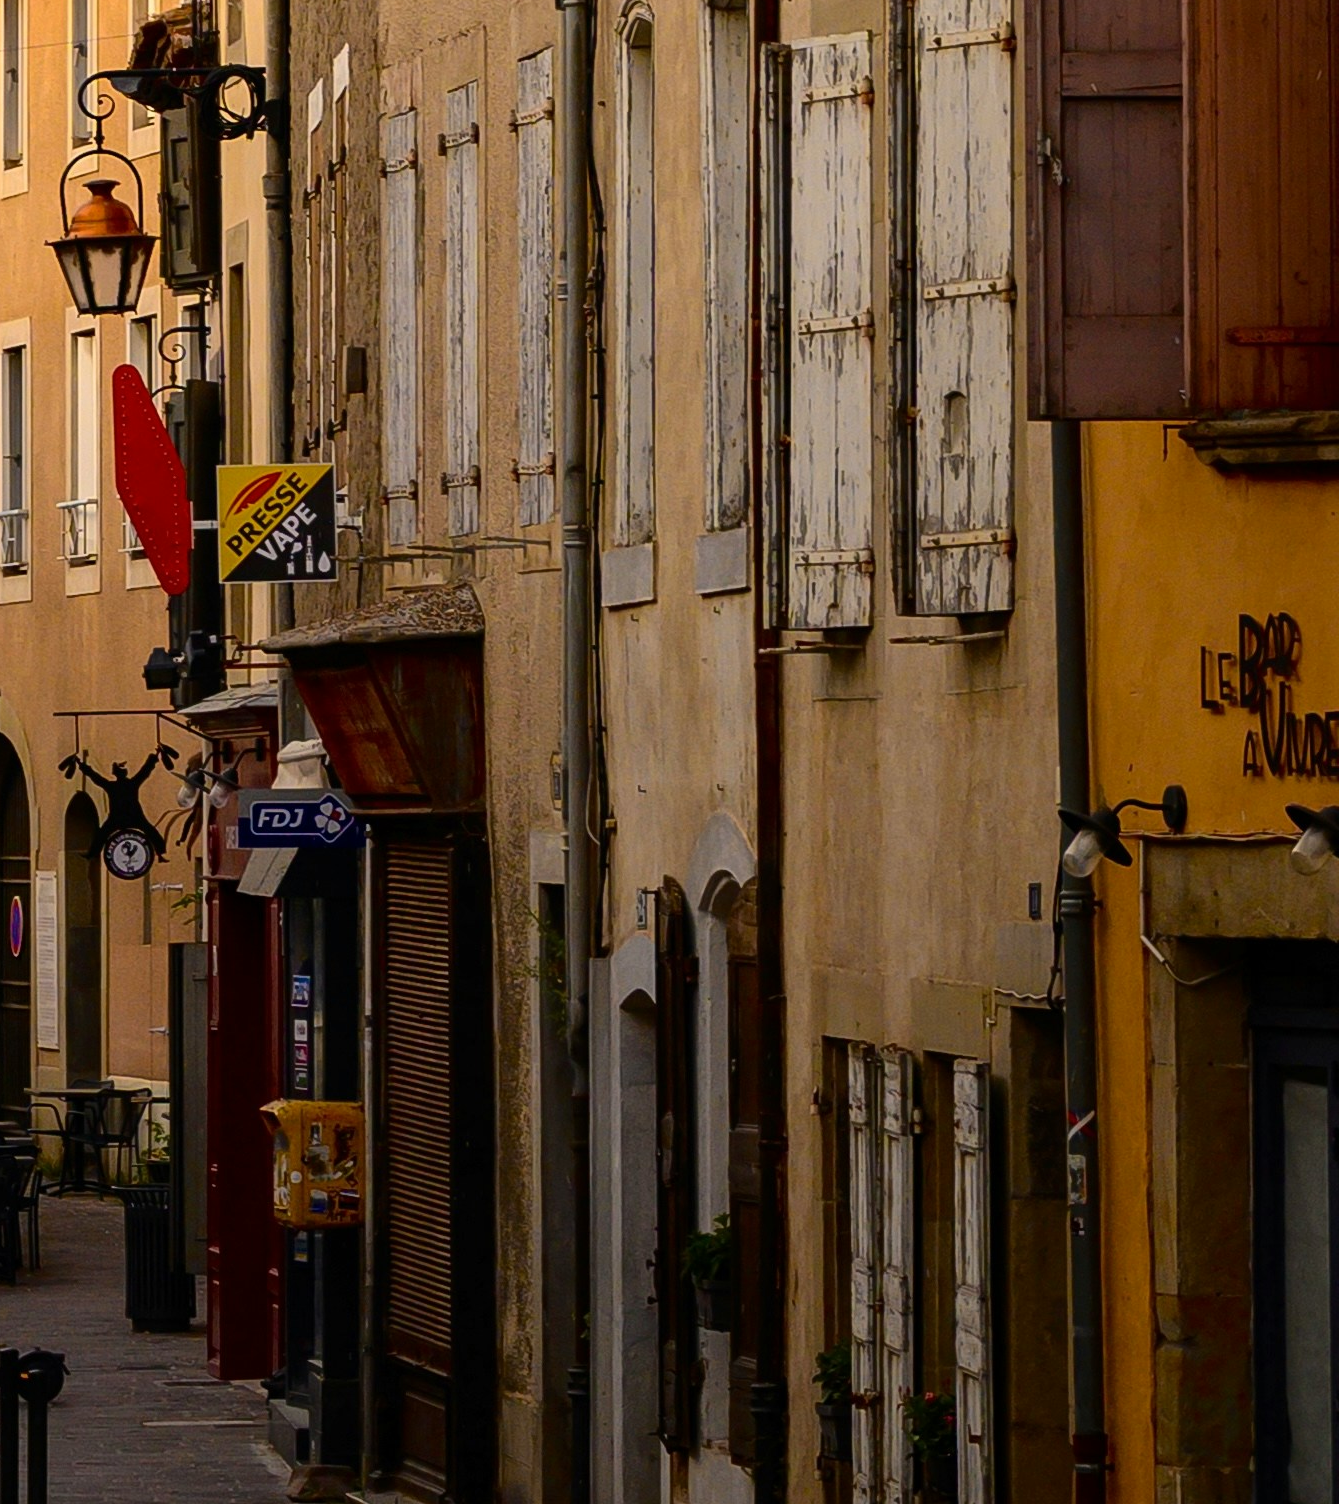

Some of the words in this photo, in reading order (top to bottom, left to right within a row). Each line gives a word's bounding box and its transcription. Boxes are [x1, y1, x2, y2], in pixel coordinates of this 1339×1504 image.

[224, 471, 309, 557] PRESSE
[255, 502, 318, 561] VAPE
[1200, 645, 1235, 710] LE
[1238, 612, 1299, 709] BAR
[1258, 681, 1339, 777] VIVRE
[257, 808, 305, 828] FDJ
